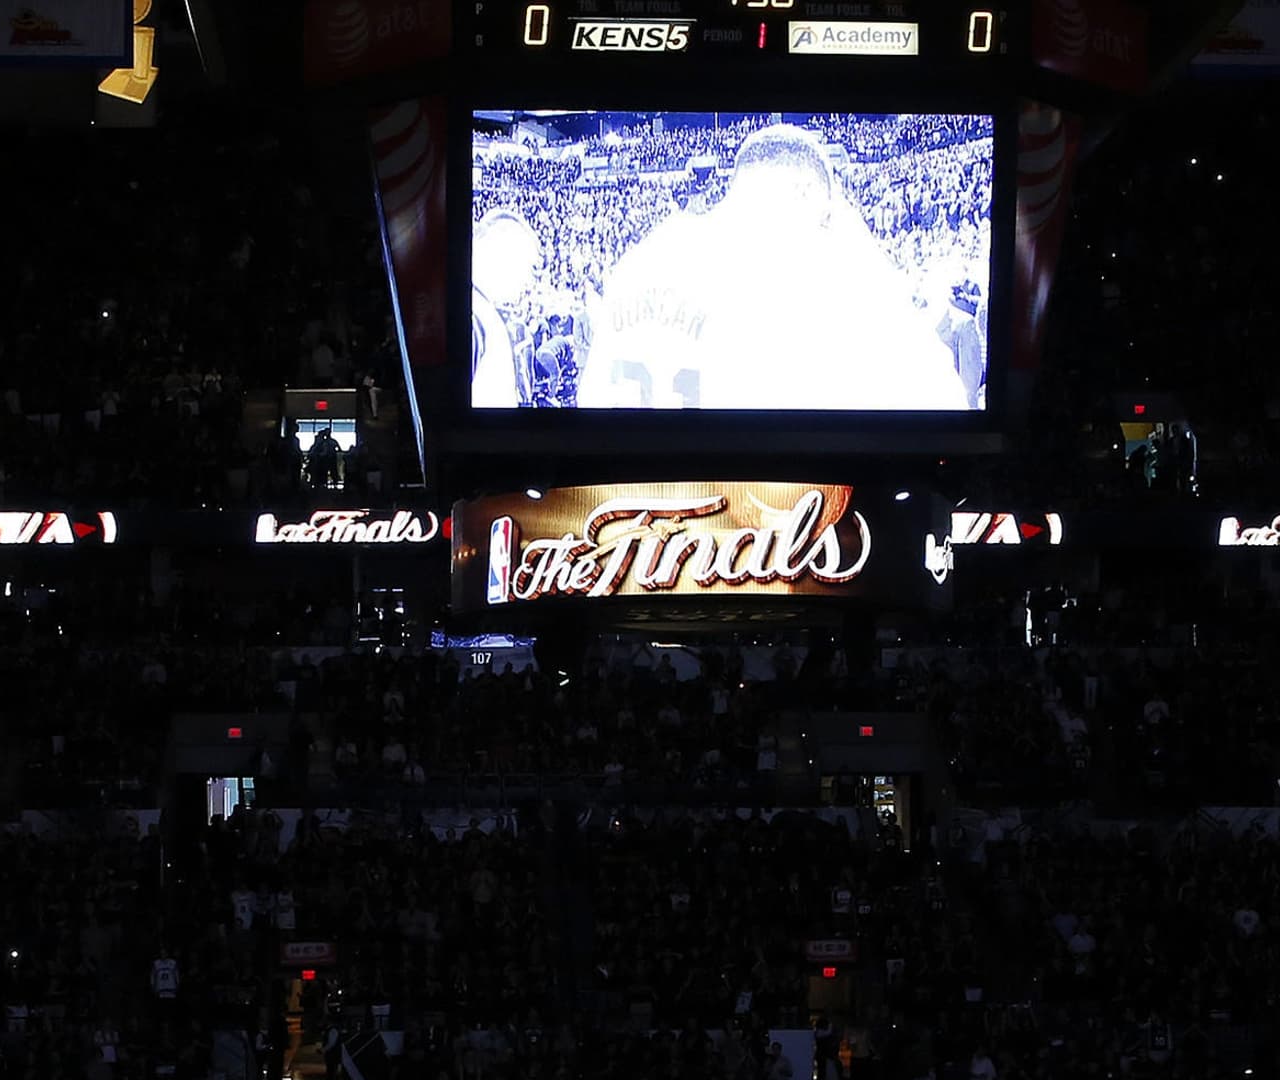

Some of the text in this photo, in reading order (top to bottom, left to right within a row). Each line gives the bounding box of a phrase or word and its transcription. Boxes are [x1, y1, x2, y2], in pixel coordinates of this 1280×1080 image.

[524, 5, 549, 45] 0
[822, 26, 911, 48] Academy
[968, 12, 993, 52] 0
[513, 490, 872, 599] The Finals
[471, 651, 493, 665] 107
